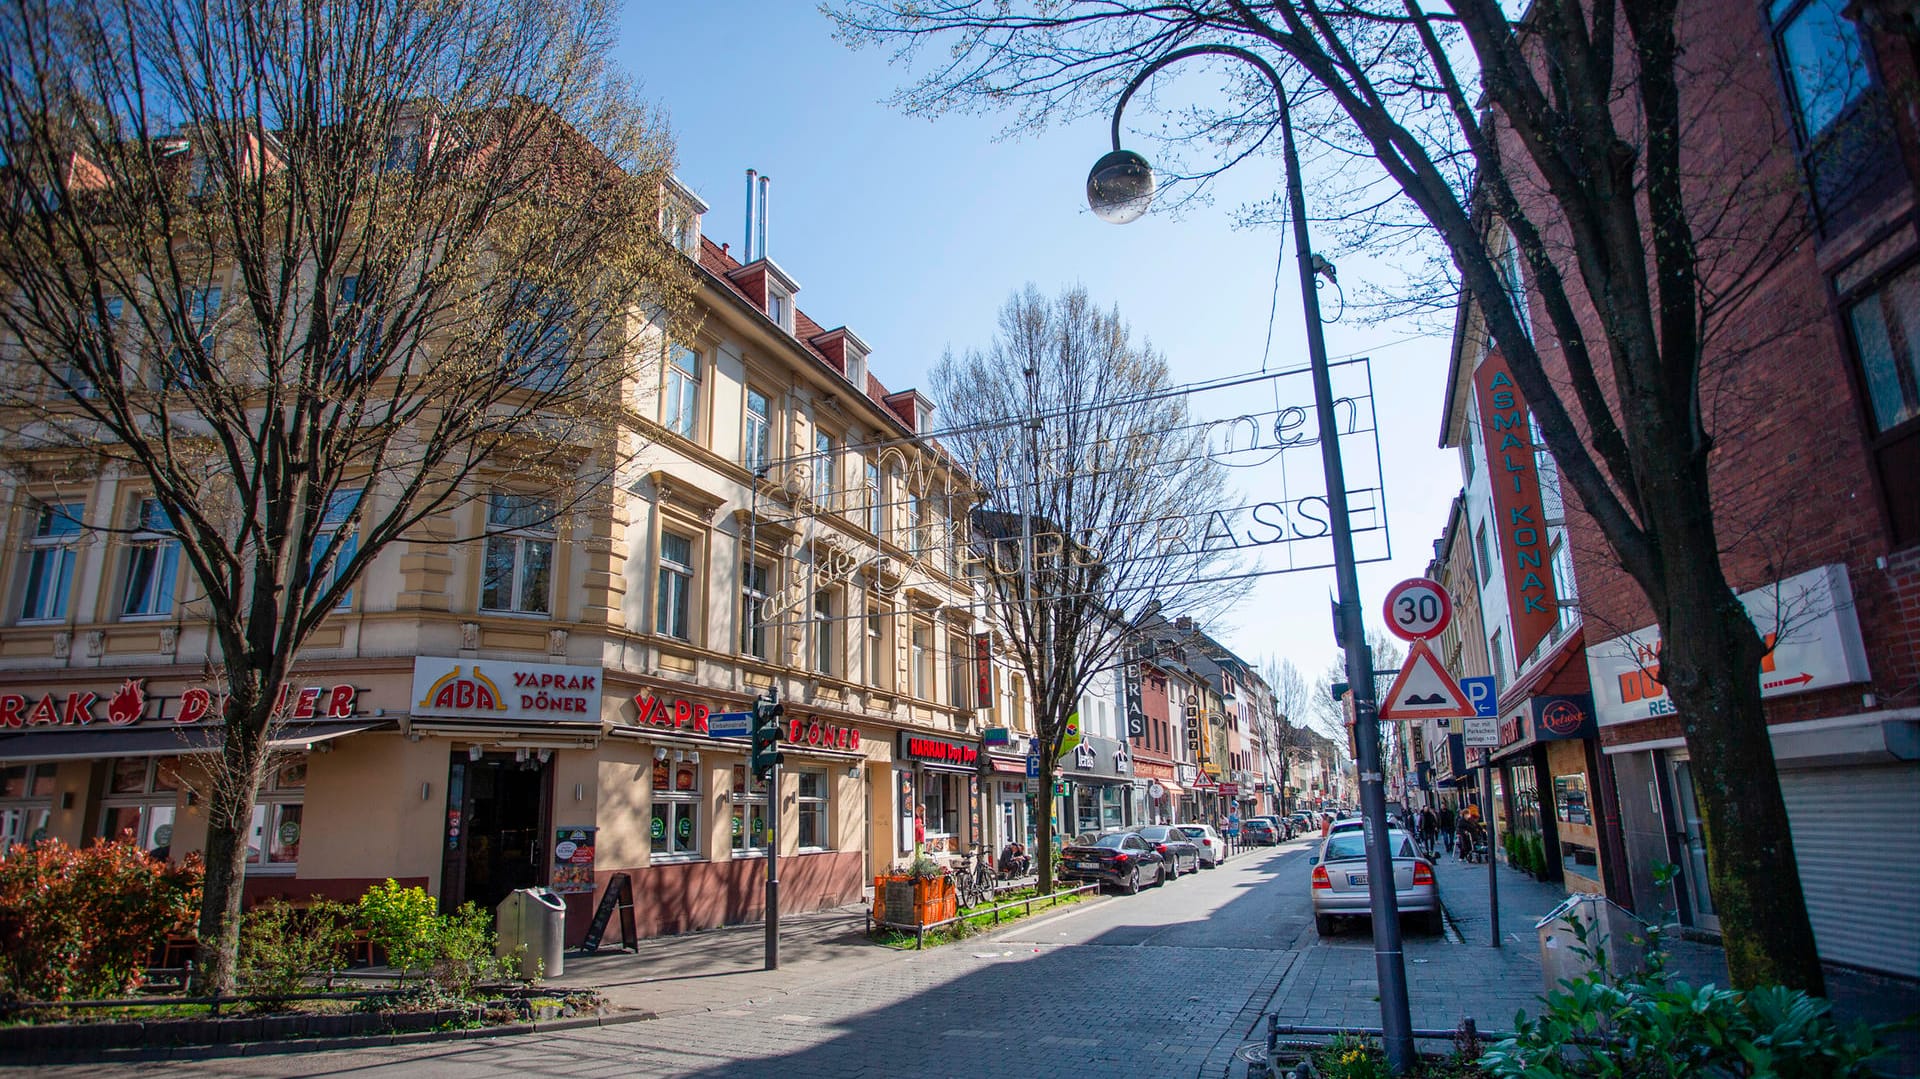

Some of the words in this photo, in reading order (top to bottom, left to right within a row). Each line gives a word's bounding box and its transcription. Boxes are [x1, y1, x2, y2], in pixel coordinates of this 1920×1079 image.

[1489, 371, 1524, 493] ASMALI
[1511, 505, 1548, 614] KONAK
[1398, 595, 1438, 625] 30
[435, 680, 494, 710] ABA
[513, 672, 595, 690] YAPRAK
[521, 692, 587, 713] DÖNER
[1469, 682, 1488, 709] P
[788, 715, 861, 751] DÖNER
[910, 737, 946, 759] HARRAN
